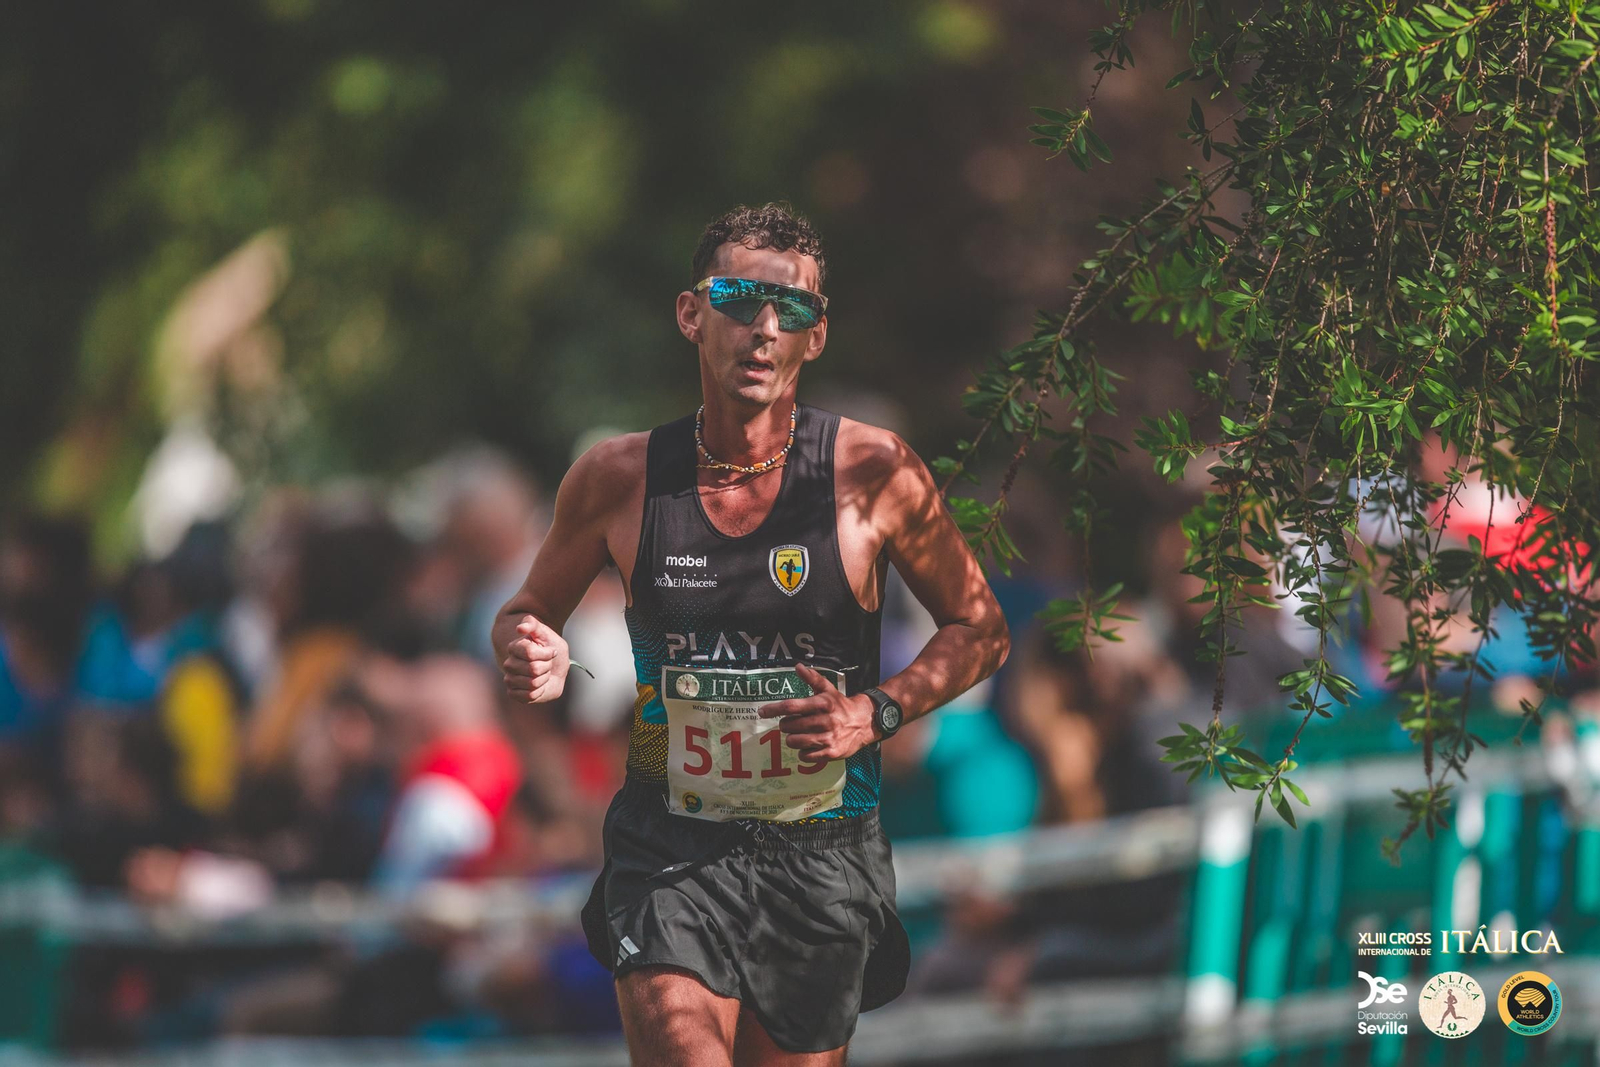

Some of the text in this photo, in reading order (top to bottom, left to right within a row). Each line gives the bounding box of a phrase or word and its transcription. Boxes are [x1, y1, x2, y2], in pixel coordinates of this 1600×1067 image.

[666, 554, 707, 567] mobel
[674, 578, 680, 588] El
[682, 578, 718, 588] Palacete
[665, 631, 815, 661] PLAYAS
[712, 676, 795, 696] ITÁLICA
[692, 704, 759, 714] RODRÍGUEZ HERN
